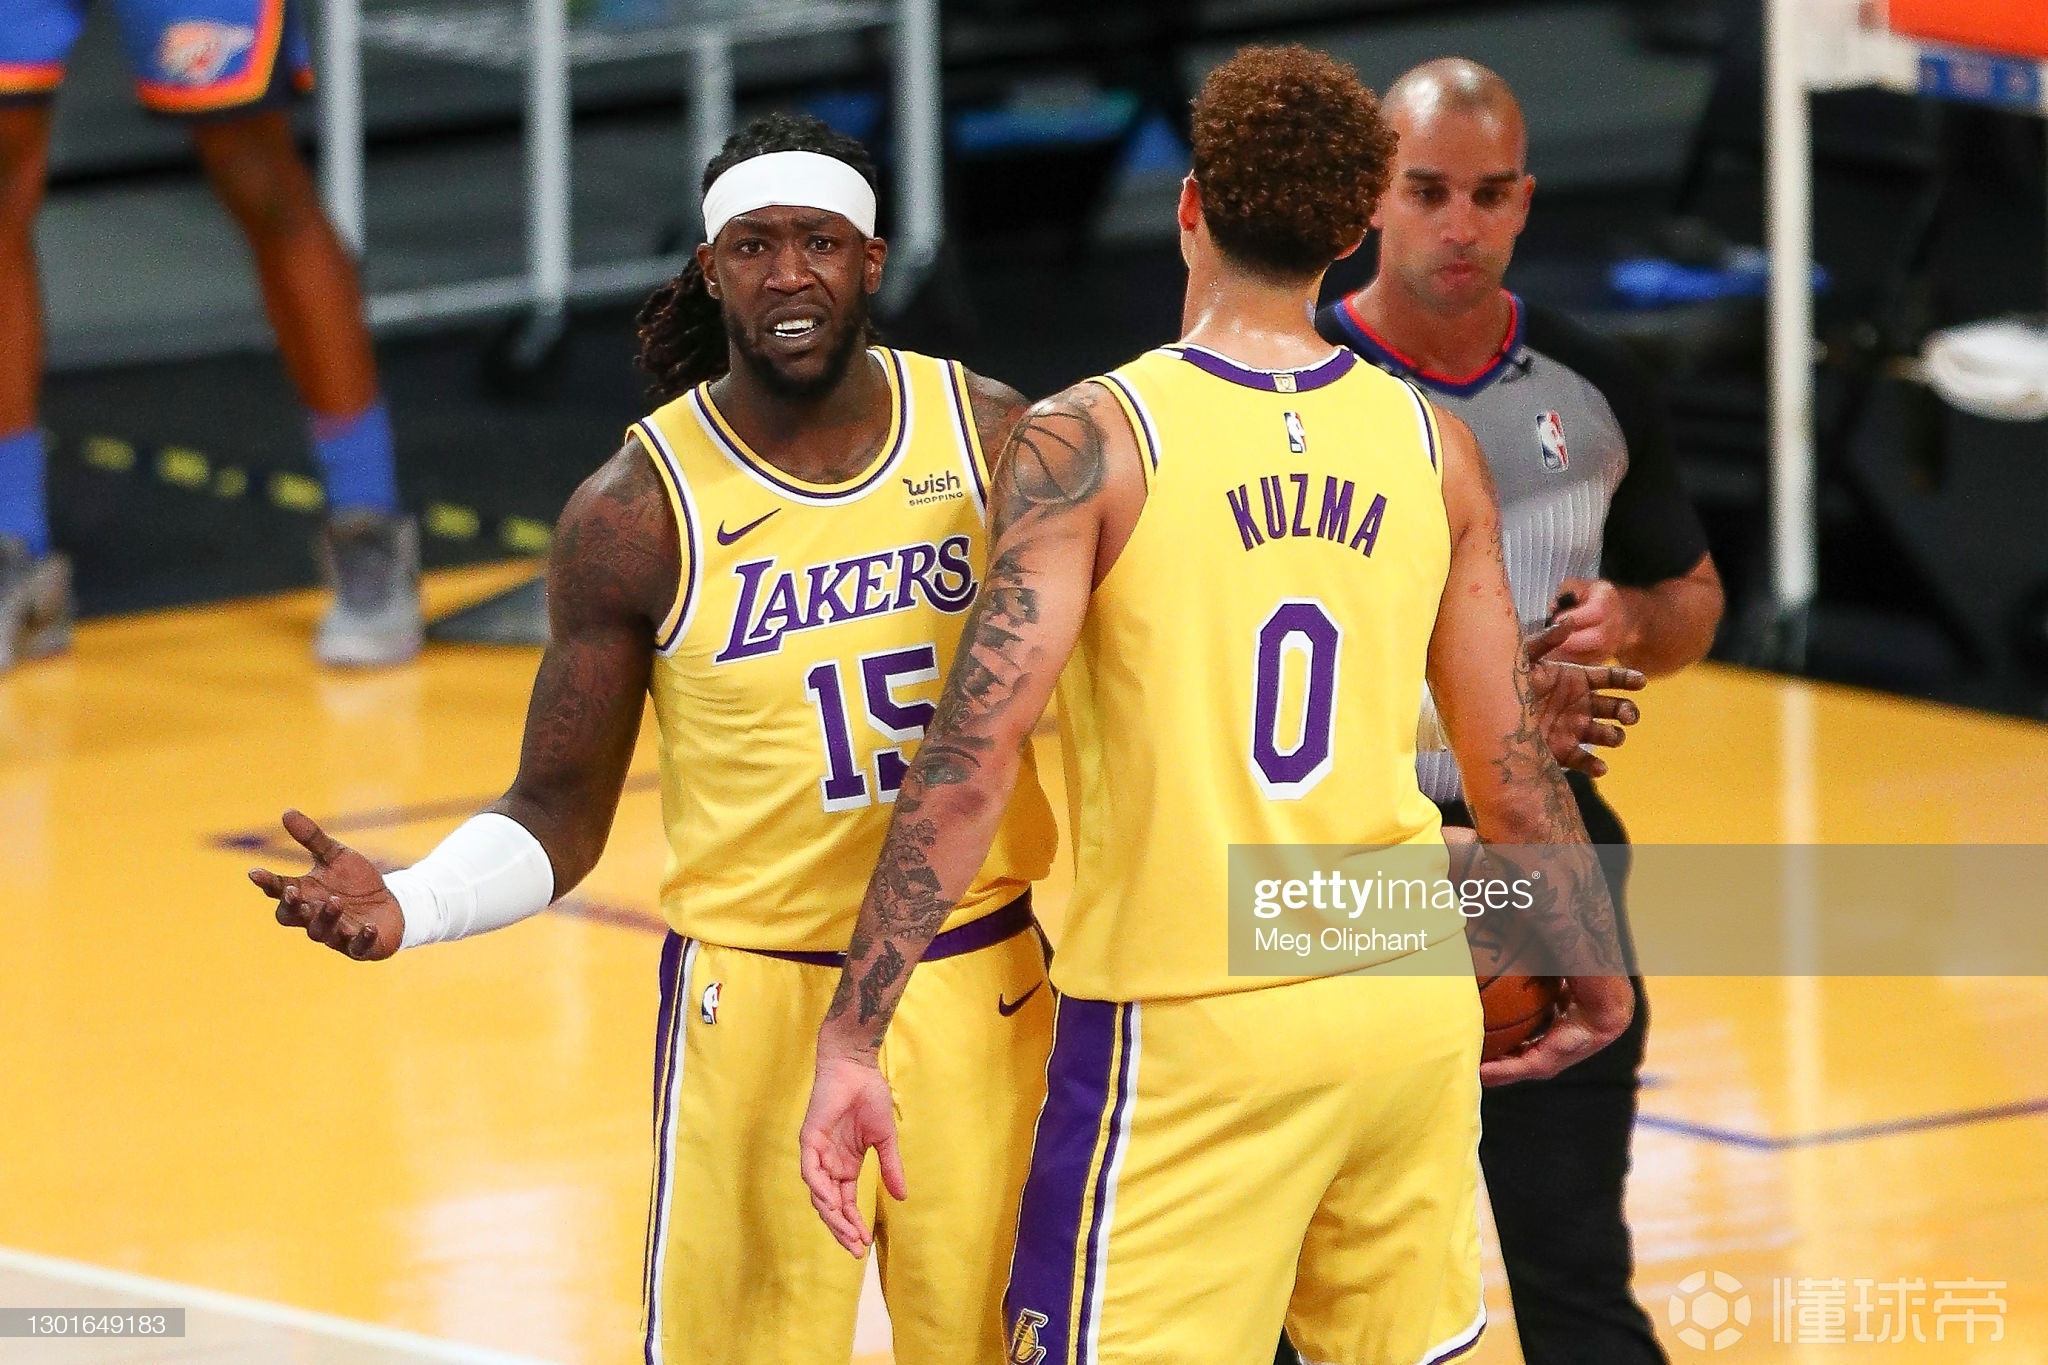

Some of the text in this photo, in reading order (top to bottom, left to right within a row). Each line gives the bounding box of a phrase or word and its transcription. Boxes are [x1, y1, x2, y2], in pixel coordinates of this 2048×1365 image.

[902, 470, 960, 496] wish
[909, 491, 964, 507] SHOPPING
[1226, 473, 1387, 558] KUZMA
[712, 534, 979, 666] LAKERS
[804, 642, 940, 813] 15
[1250, 597, 1343, 799] 0
